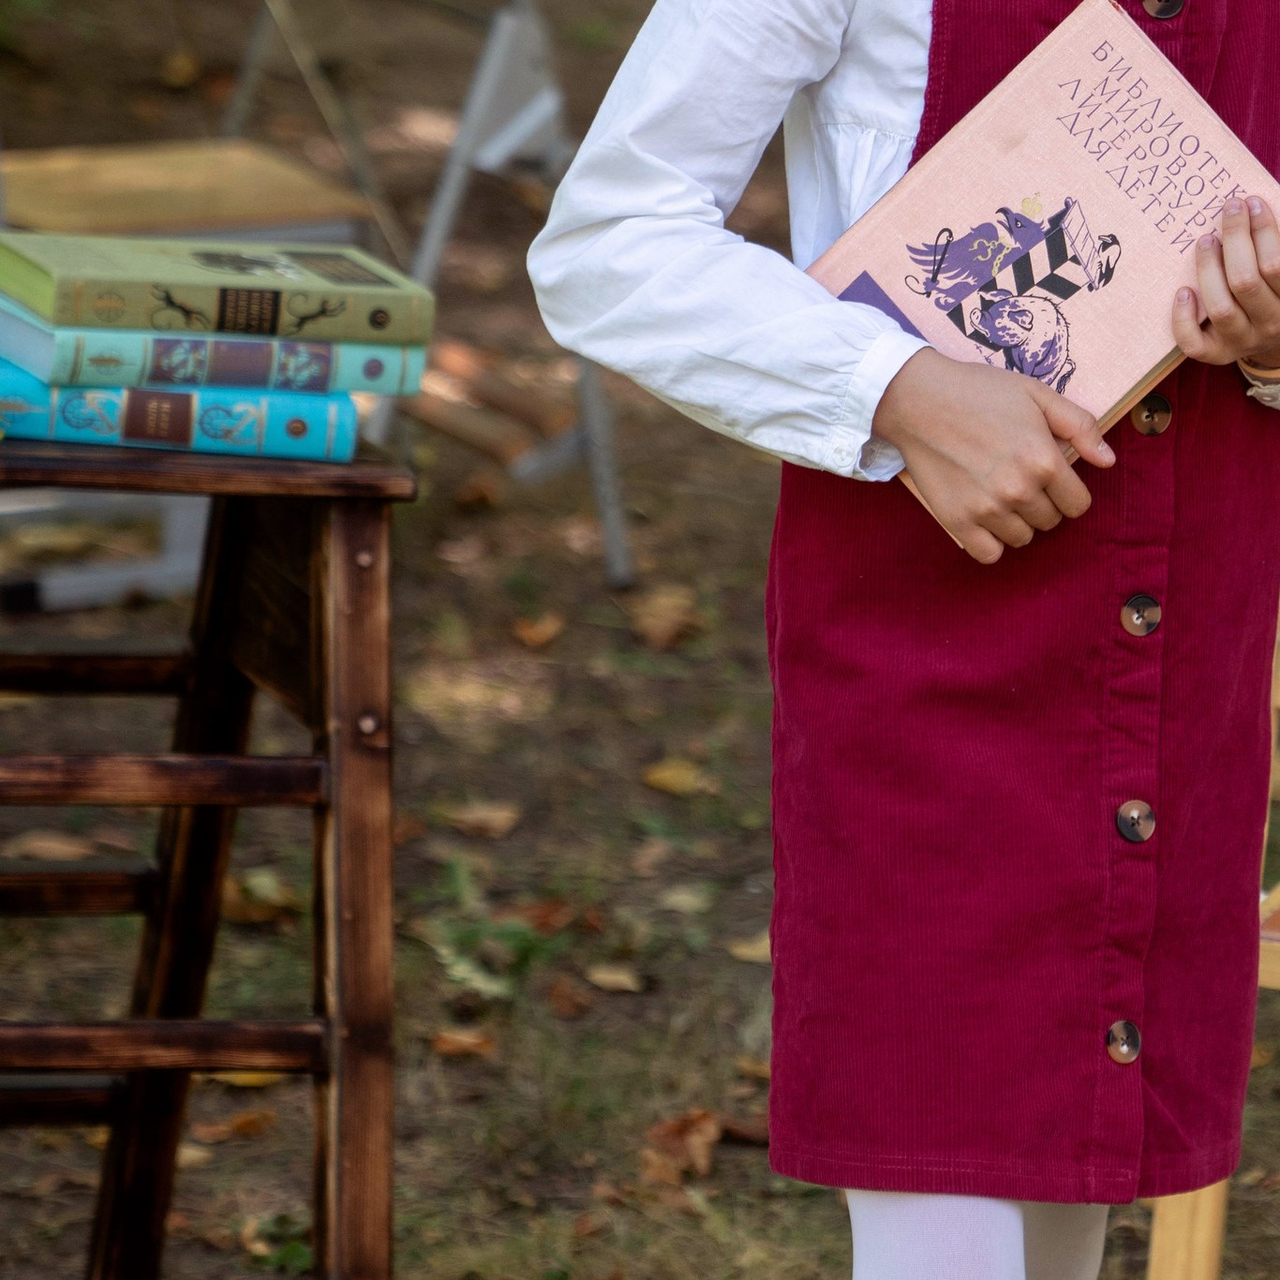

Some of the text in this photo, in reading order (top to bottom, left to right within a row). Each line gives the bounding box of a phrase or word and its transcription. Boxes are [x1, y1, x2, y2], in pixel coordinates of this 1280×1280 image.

[1056, 111, 1198, 255] ДЛЯ ДЕТЕЙ
[1058, 78, 1218, 235] ЛИТЕРАТУР
[1091, 40, 1247, 201] БИБЛИОТЕК
[1093, 76, 1225, 221] МИРОВОЙ
